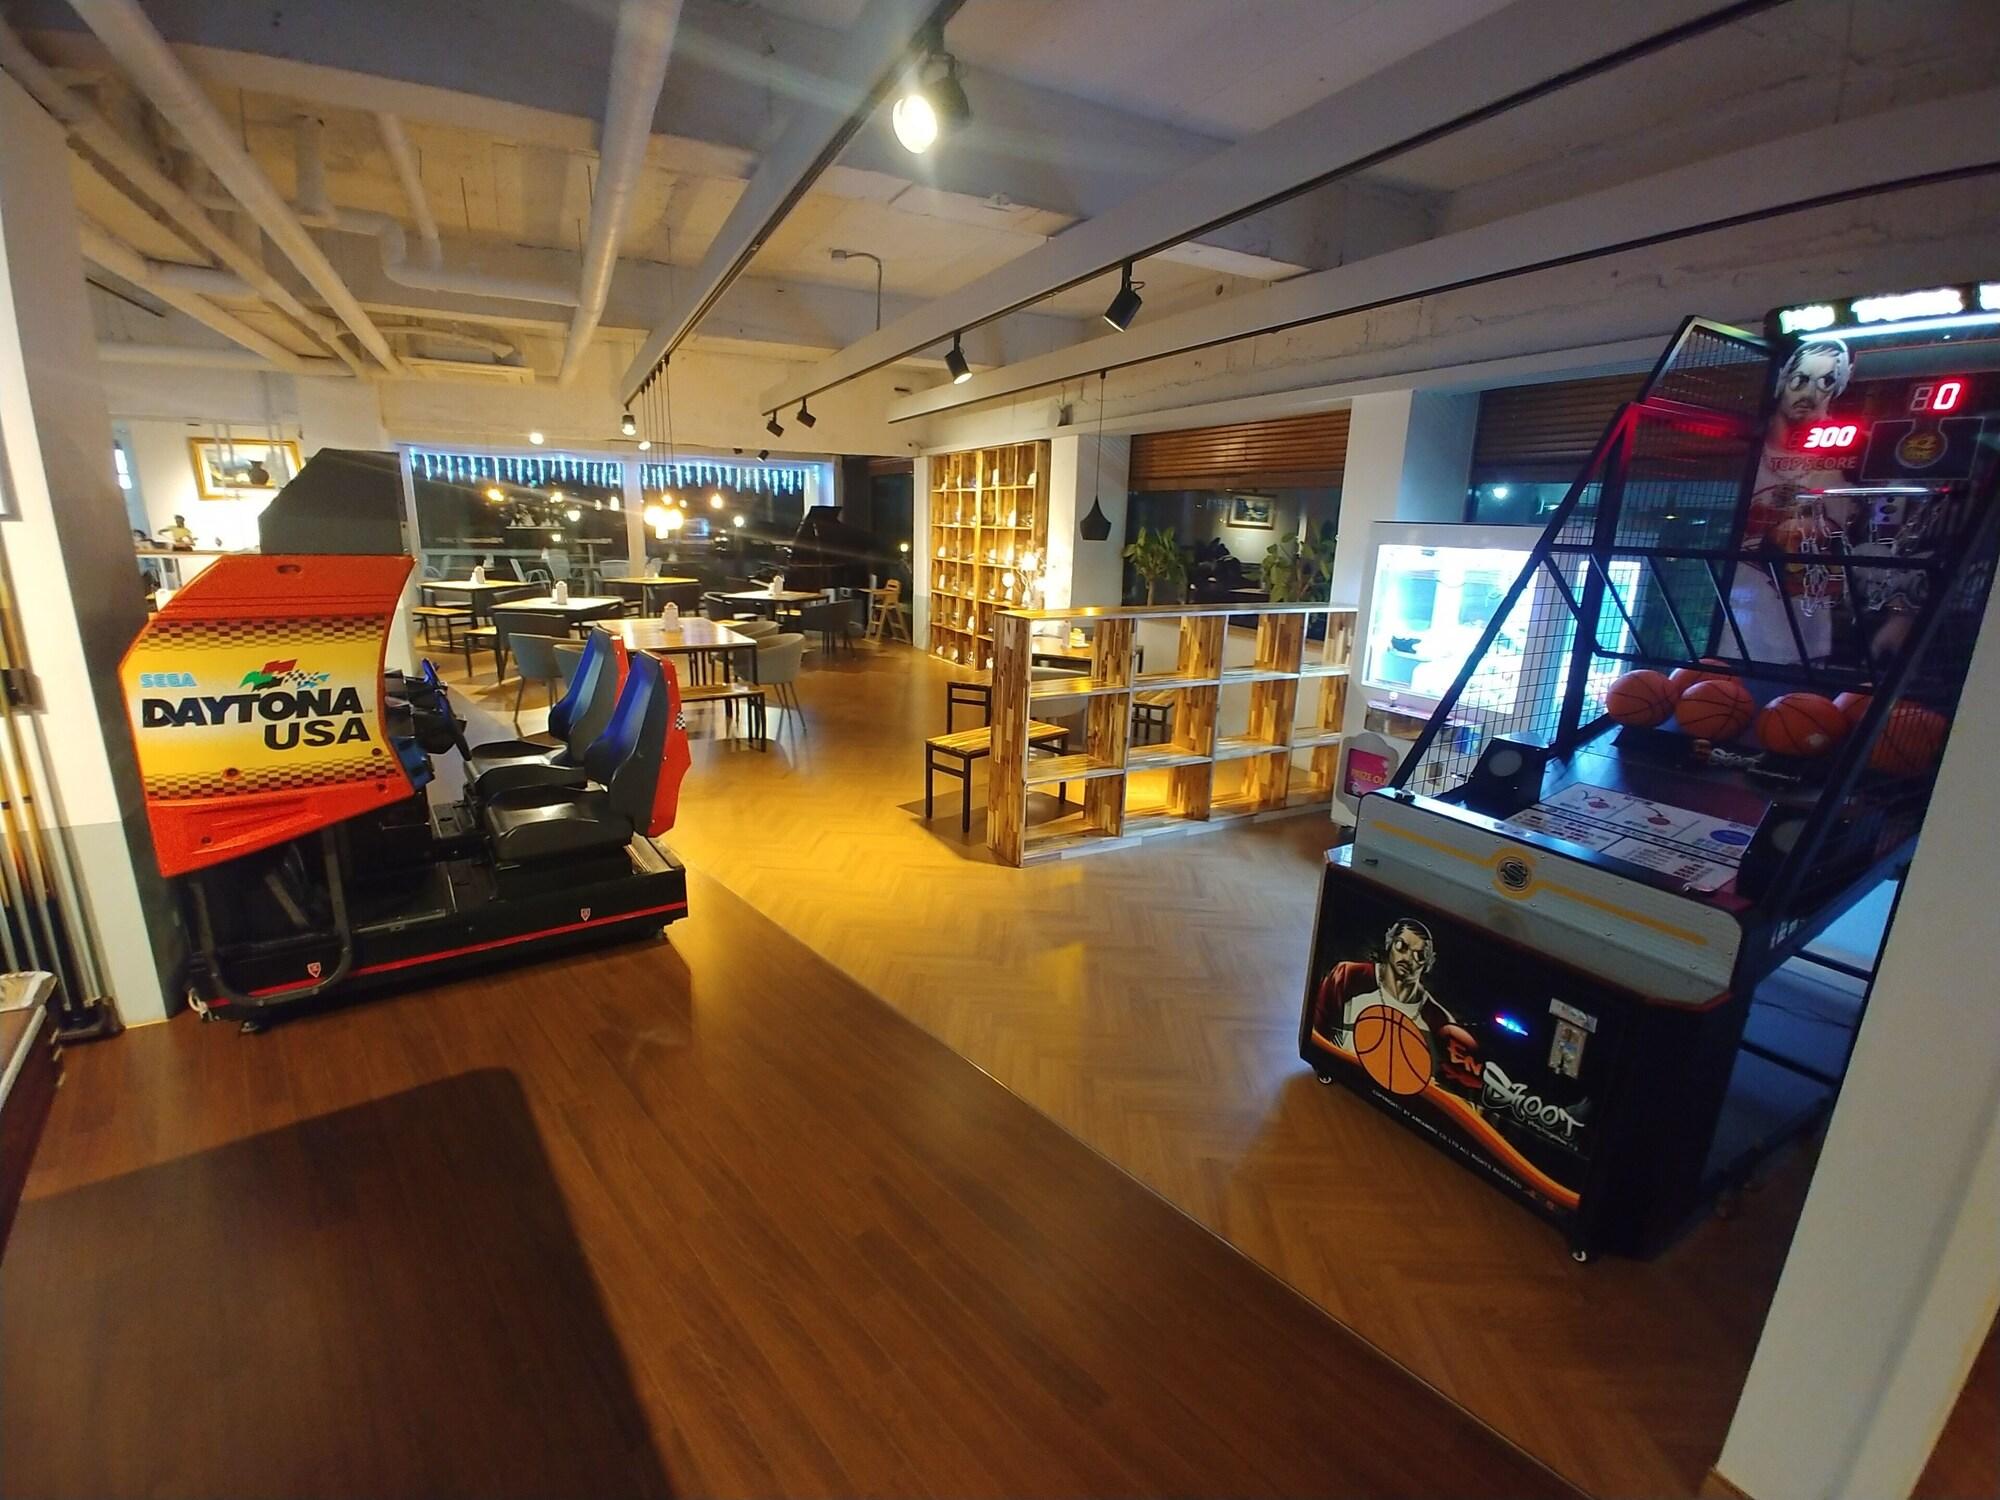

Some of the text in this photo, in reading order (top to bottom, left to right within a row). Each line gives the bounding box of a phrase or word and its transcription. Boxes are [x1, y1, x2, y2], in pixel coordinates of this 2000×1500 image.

[1933, 383, 1961, 411] 0
[1803, 425, 1858, 448] 300
[1803, 455, 1858, 471] SCORE
[139, 672, 198, 689] SEGA
[142, 686, 364, 728] DAYTONA
[264, 717, 371, 750] USA
